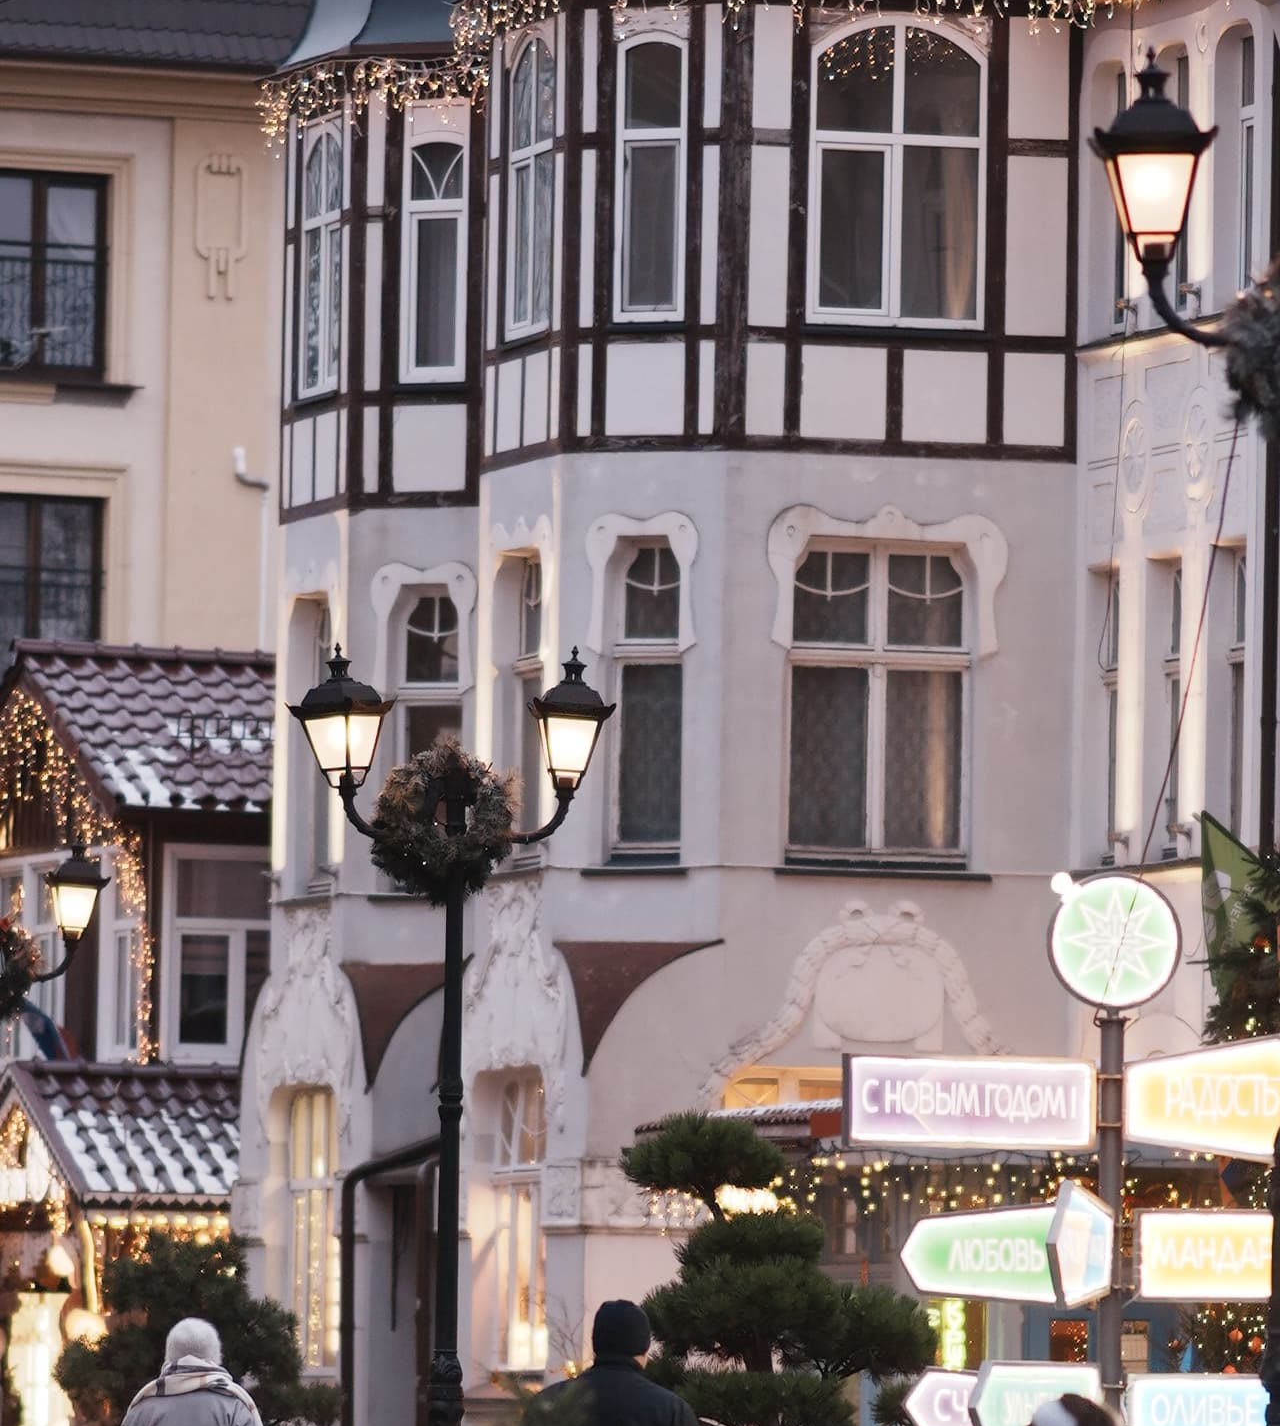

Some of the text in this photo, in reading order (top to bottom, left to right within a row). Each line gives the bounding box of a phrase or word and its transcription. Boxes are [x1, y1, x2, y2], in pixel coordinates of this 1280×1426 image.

[862, 1078, 879, 1114] С
[884, 1079, 980, 1117] НОВЫМ
[1165, 1073, 1280, 1121] РАДОСТЬ
[948, 1237, 1046, 1273] ЛЮБОВЬ
[933, 1389, 969, 1422] СЧ
